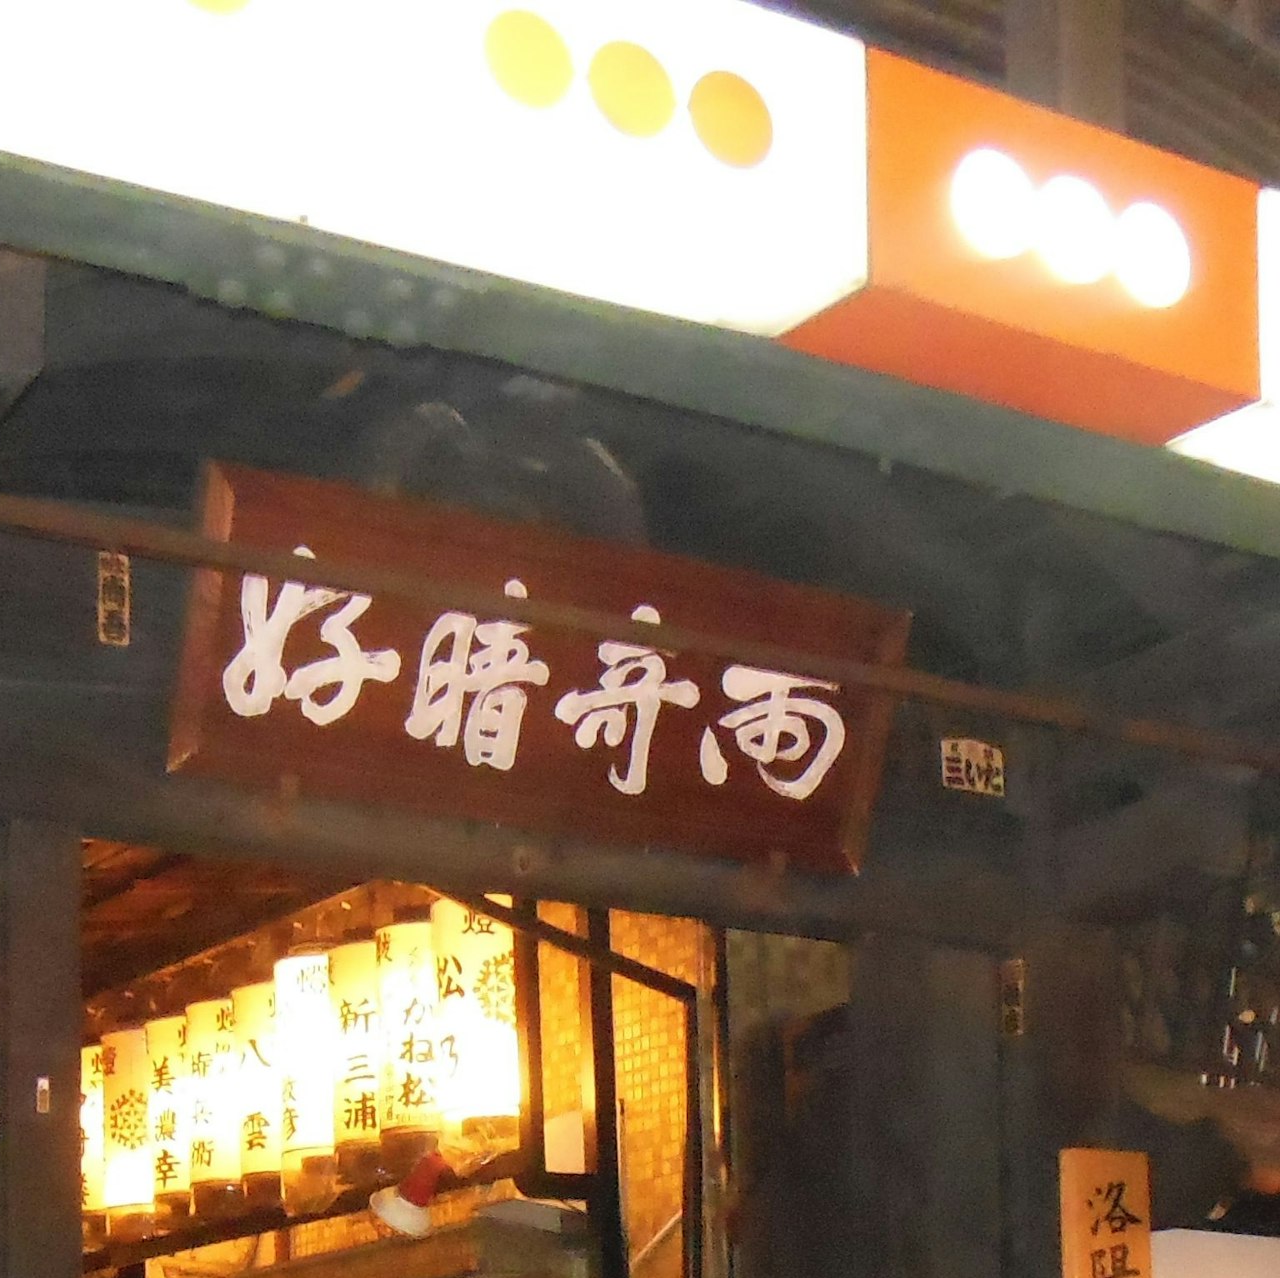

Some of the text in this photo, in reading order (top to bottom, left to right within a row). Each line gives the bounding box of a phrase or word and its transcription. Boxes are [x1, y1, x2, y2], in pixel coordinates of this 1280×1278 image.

[150, 1055, 180, 1190] 美濃幸
[240, 1038, 271, 1151] 八雲
[339, 998, 377, 1131] 新三浦
